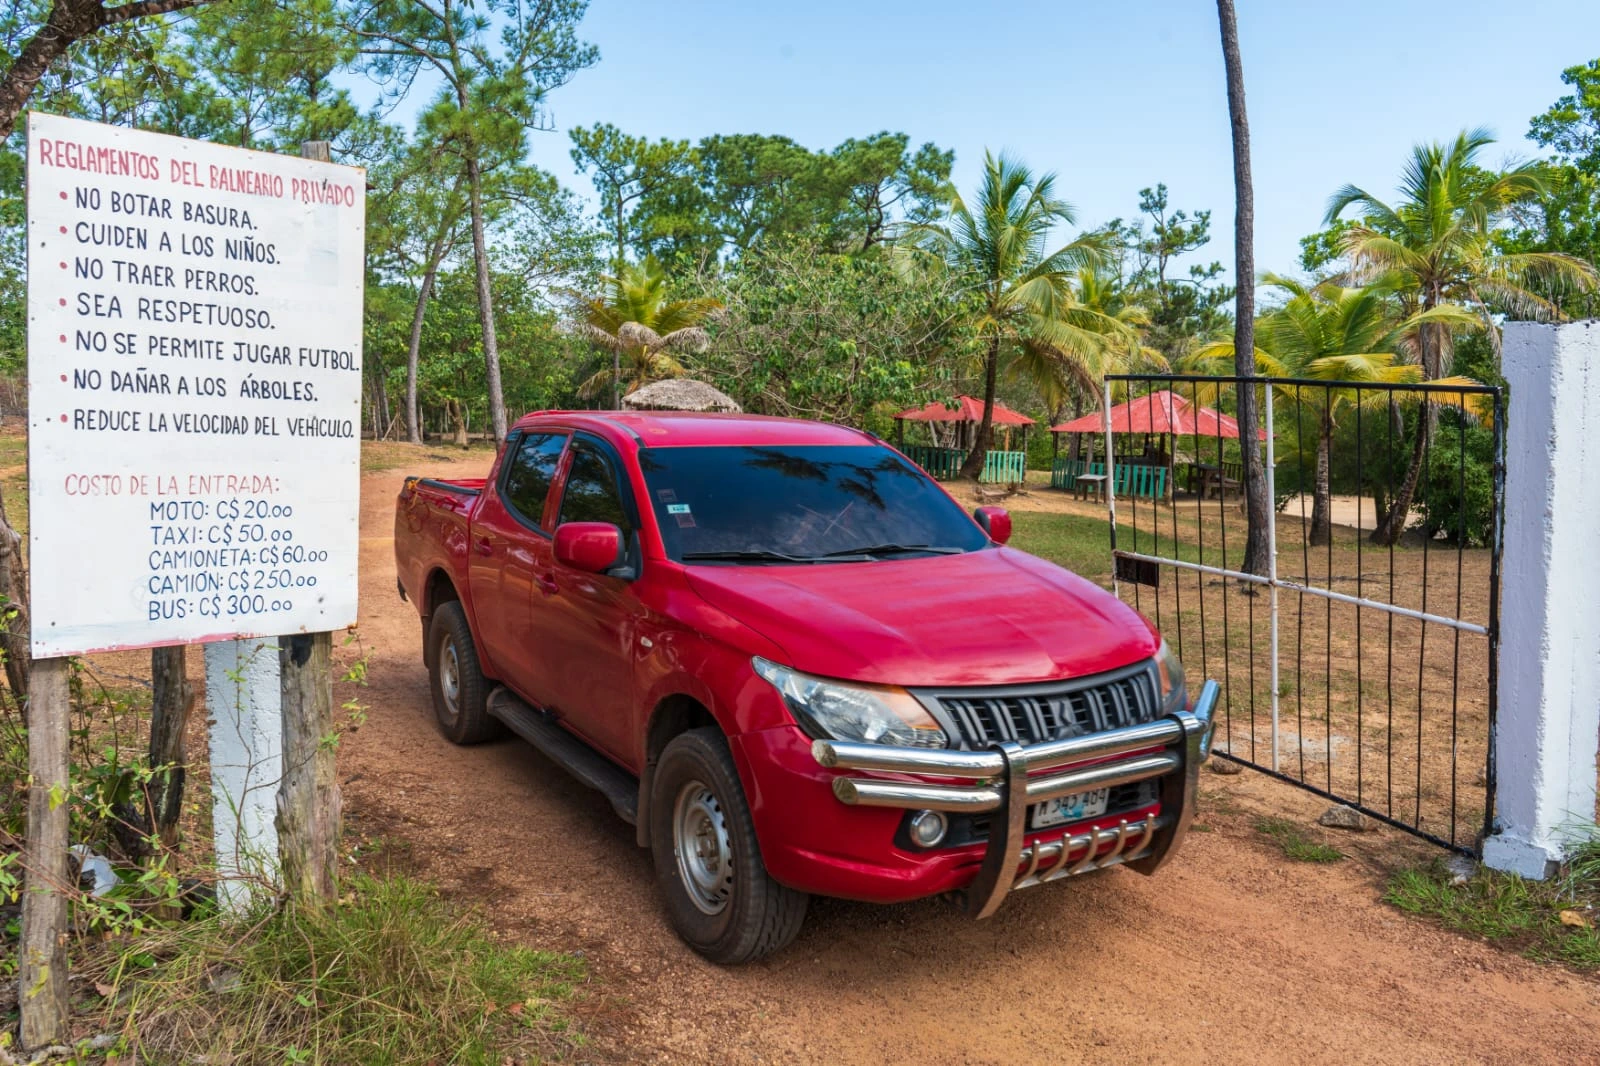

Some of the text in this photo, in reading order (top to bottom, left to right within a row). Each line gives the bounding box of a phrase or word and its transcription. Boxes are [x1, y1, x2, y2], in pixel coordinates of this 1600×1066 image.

[39, 138, 355, 207] REGLAMENTOS DEL BALNEARIO PRIVADO
[75, 187, 258, 230] NO BOTAR BASURA.
[75, 221, 282, 265] CUIDEN A LOS NIÑOS.
[74, 256, 260, 296] NO TRAER PERROS.
[76, 292, 276, 330] SEA RESPETUOSO.
[75, 330, 360, 371] NO SE PERMITE JUGAR FUTBOL.
[73, 367, 319, 402] NO DAÑAR A LOS ÁRBOLES.
[73, 409, 141, 432] REDUCE
[149, 412, 168, 433] LA
[173, 414, 249, 435] VELOCIDAD
[254, 416, 280, 437] DEL
[64, 473, 280, 496] COSTO DE LA ENTRADA:
[149, 501, 210, 521] MOTO:
[150, 525, 203, 545] TAXI:
[149, 548, 257, 570] CAMIONETA:
[149, 598, 194, 621] BUS:
